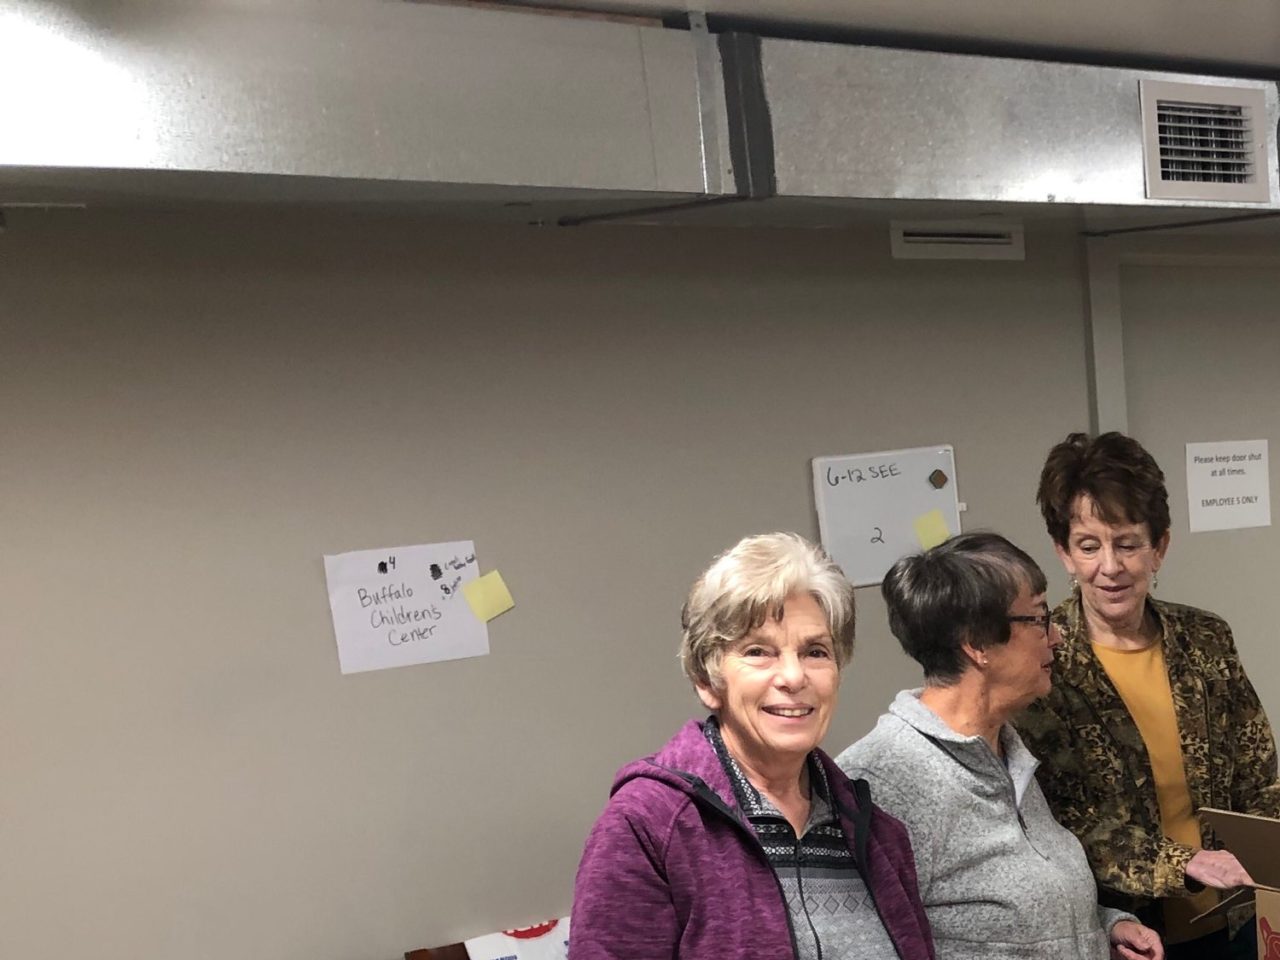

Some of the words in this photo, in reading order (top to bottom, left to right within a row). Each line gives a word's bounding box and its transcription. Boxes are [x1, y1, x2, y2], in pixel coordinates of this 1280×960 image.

[1193, 455, 1214, 464] Please
[1215, 454, 1230, 463] keep
[1231, 453, 1247, 462] door
[1248, 452, 1262, 461] shut
[868, 463, 901, 480] SEE
[1210, 469, 1217, 477] at
[1218, 467, 1226, 476] all
[1241, 495, 1259, 505] ONLY
[870, 526, 885, 544] 2
[388, 556, 396, 569] 4
[357, 582, 413, 608] Buffalo
[370, 602, 442, 629] Children's
[387, 625, 437, 646] Center
